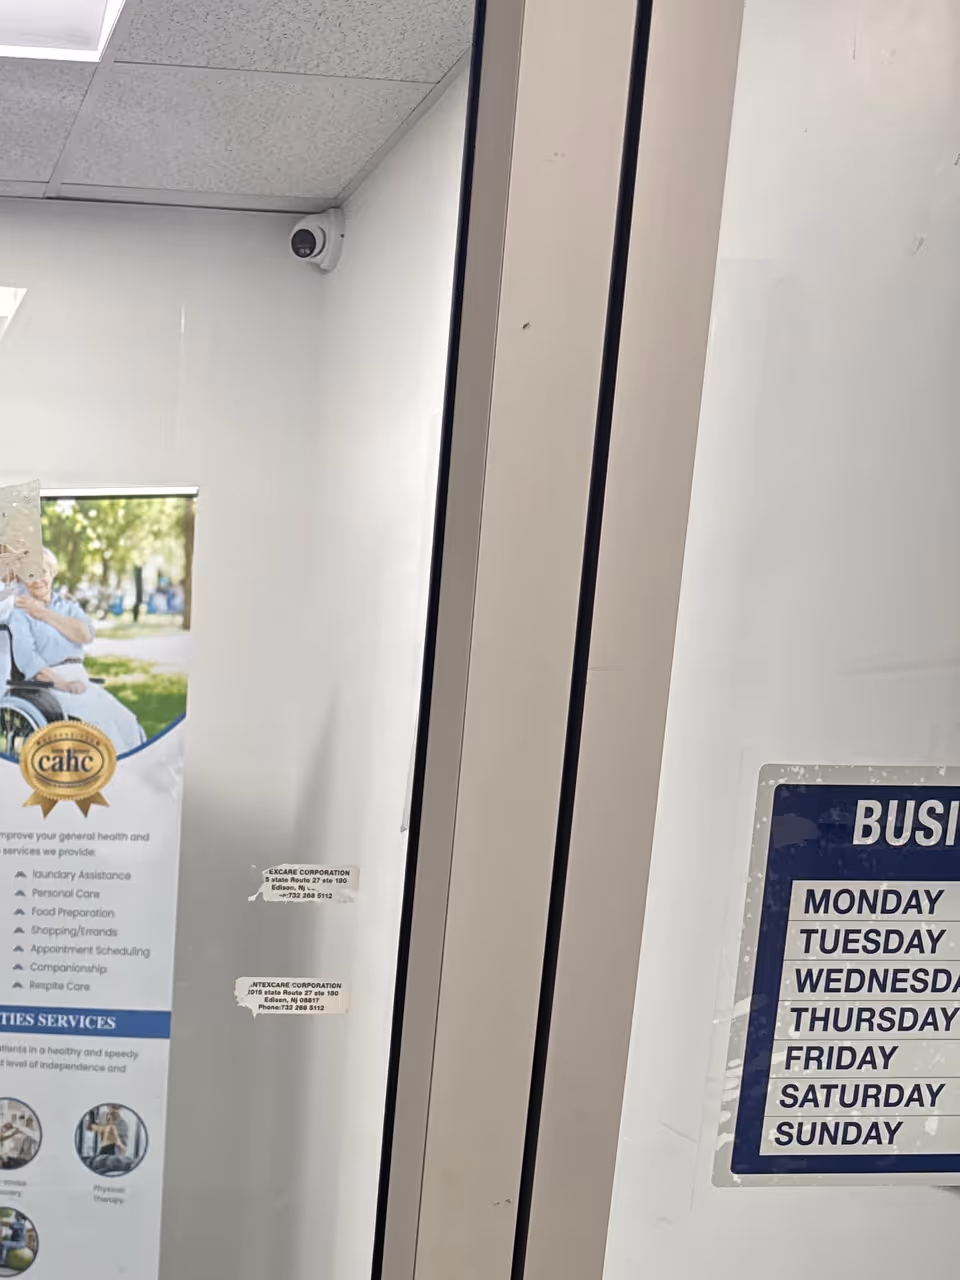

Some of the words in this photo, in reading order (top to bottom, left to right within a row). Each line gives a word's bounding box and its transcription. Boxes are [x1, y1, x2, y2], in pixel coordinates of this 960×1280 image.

[38, 749, 94, 772] cahc
[852, 800, 960, 846] BUSI
[36, 832, 56, 842] your
[59, 832, 95, 842] general
[97, 832, 128, 841] health
[130, 832, 150, 842] and
[3, 847, 40, 855] services
[42, 848, 56, 856] we
[78, 870, 131, 880] Assistance
[32, 888, 73, 898] Personal
[76, 889, 100, 899] Care
[803, 888, 945, 914] MONDAY
[32, 907, 56, 917] Food
[58, 907, 114, 919] Preparation
[31, 925, 117, 938] Shopping/Errands
[799, 929, 946, 954] TUESDAY
[30, 944, 92, 955] Appointment
[96, 946, 150, 958] Scheduling
[30, 962, 107, 975] Companionship
[29, 980, 64, 992] Respite
[66, 982, 90, 991] Care
[38, 1014, 116, 1029] SERVICES
[790, 1007, 960, 1032] THURSDAY
[28, 1045, 37, 1054] in
[39, 1047, 46, 1055] a
[48, 1047, 81, 1057] healthy
[84, 1049, 102, 1057] and
[105, 1049, 138, 1060] speedy
[784, 1046, 899, 1070] FRIDAY
[6, 1059, 27, 1068] level
[28, 1060, 38, 1068] of
[40, 1061, 105, 1072] independence
[107, 1064, 126, 1073] and
[779, 1084, 946, 1108] SATURDAY
[774, 1122, 904, 1146] SUNDAY
